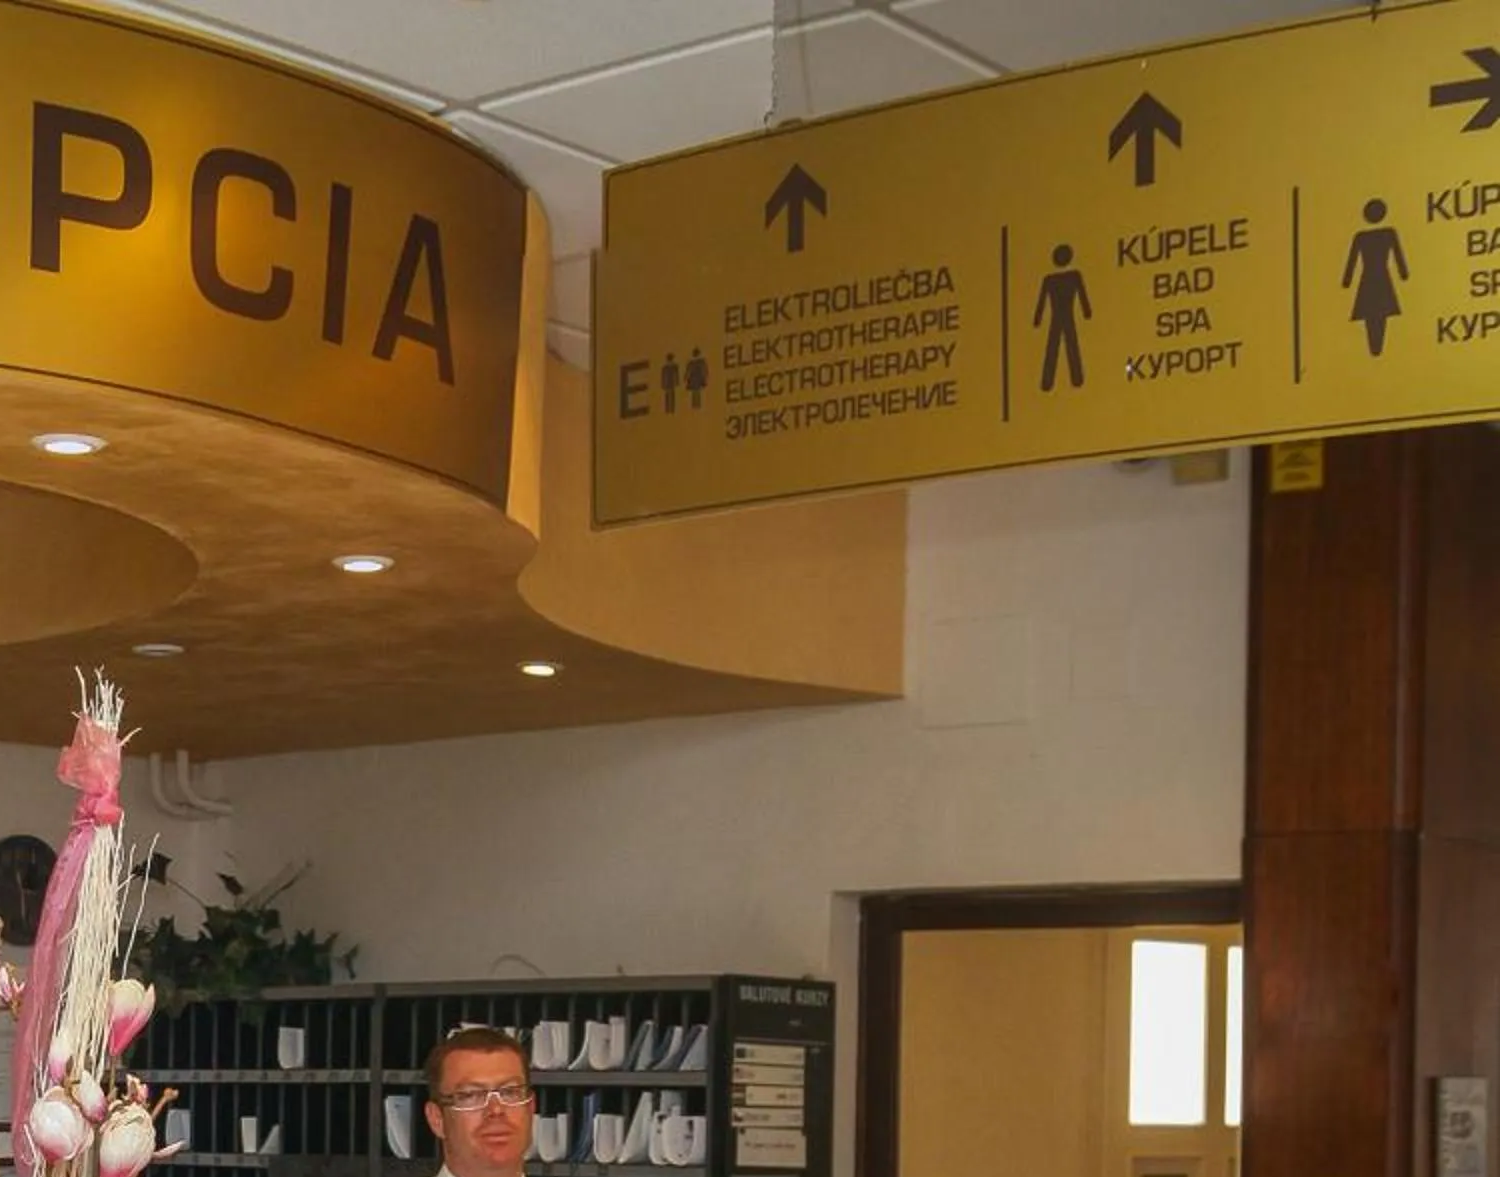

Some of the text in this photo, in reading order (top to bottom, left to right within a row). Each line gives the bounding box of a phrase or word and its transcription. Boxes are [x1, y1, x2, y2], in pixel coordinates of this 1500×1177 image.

[1117, 218, 1249, 268] KÚPELE
[724, 266, 955, 333] ELEKTROLIEČBA
[1153, 267, 1214, 299] BAD
[723, 305, 960, 370] ELEKTROTHERAPIE
[1156, 306, 1212, 338] SPA
[620, 360, 650, 419] E
[725, 341, 956, 404] ELECTROTHERAPY
[725, 380, 957, 440] ЭЛЕКТРОЛЕЧЕНИЕ
